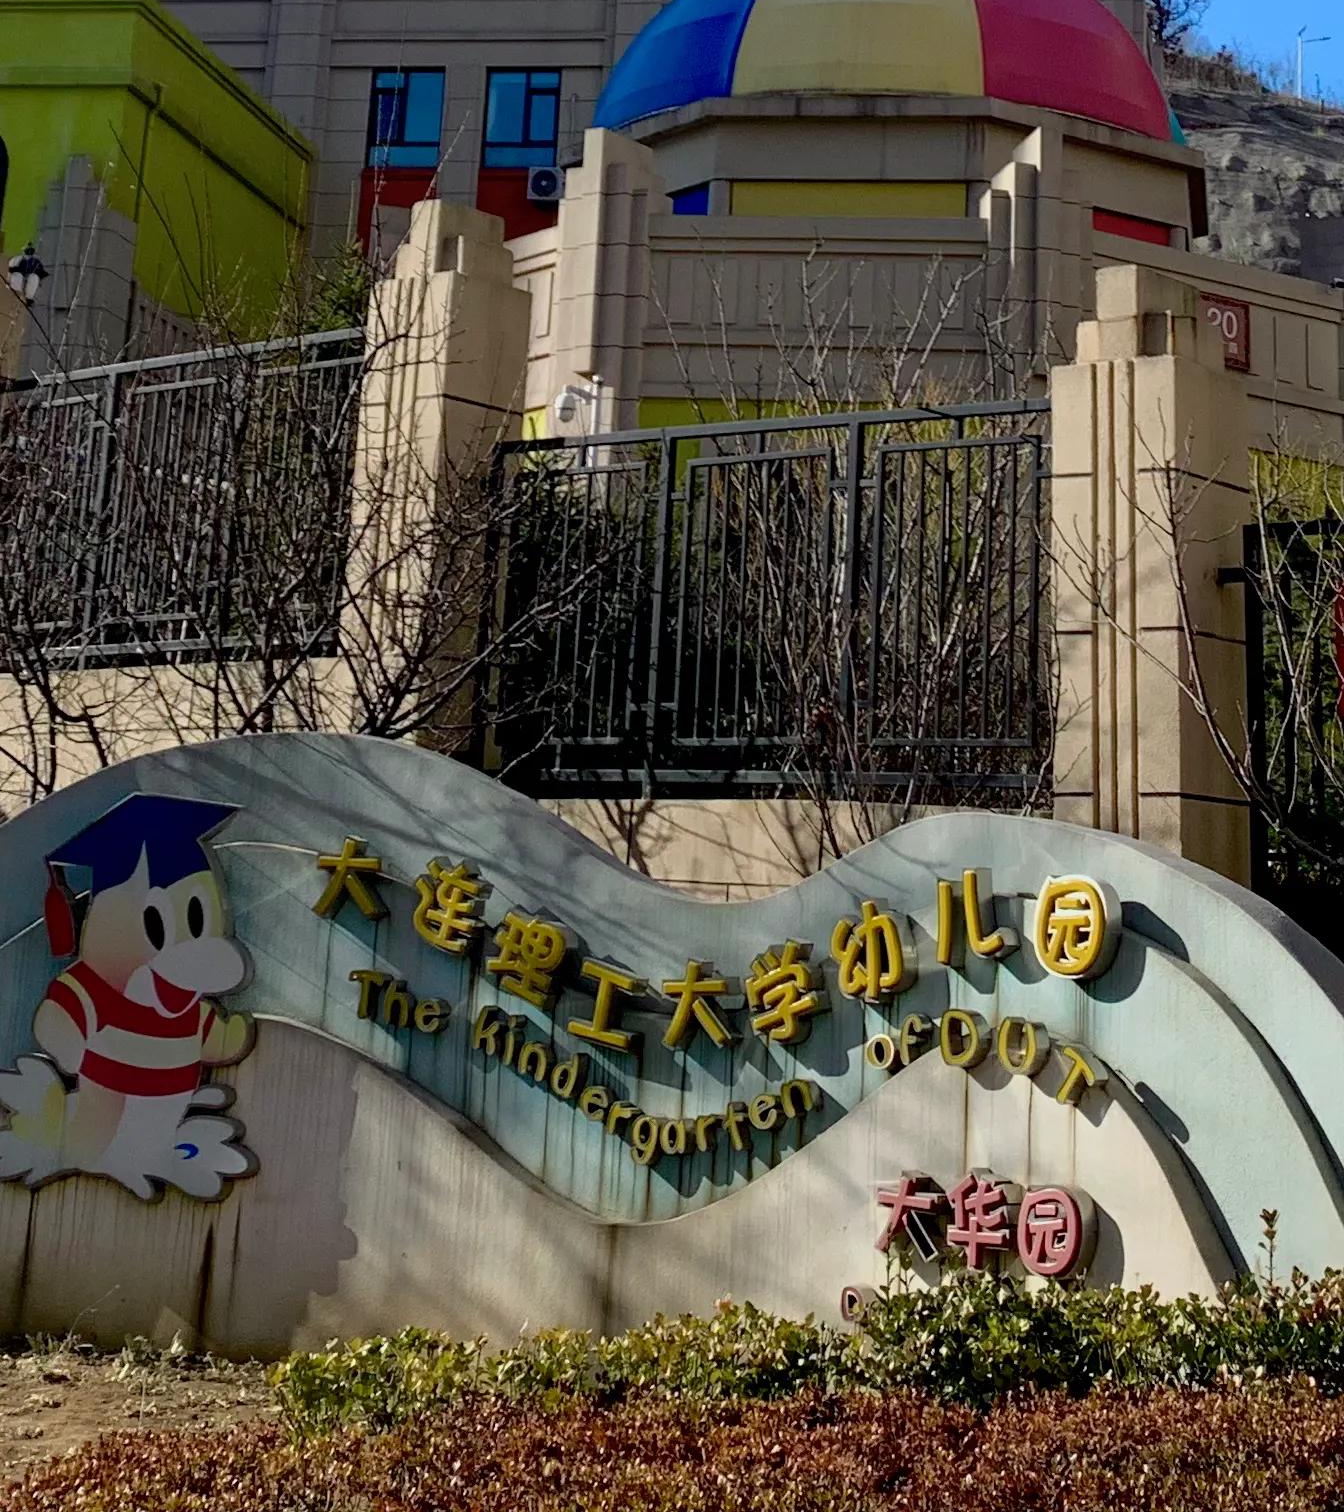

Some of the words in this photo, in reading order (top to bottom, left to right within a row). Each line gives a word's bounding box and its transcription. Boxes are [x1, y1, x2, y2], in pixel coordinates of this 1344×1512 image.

[311, 835, 1114, 1051] 大连理工大学幼儿园
[348, 969, 449, 1034] The
[864, 1013, 928, 1070] of
[939, 1008, 1102, 1105] DUT
[874, 1172, 1084, 1278] 大华园
